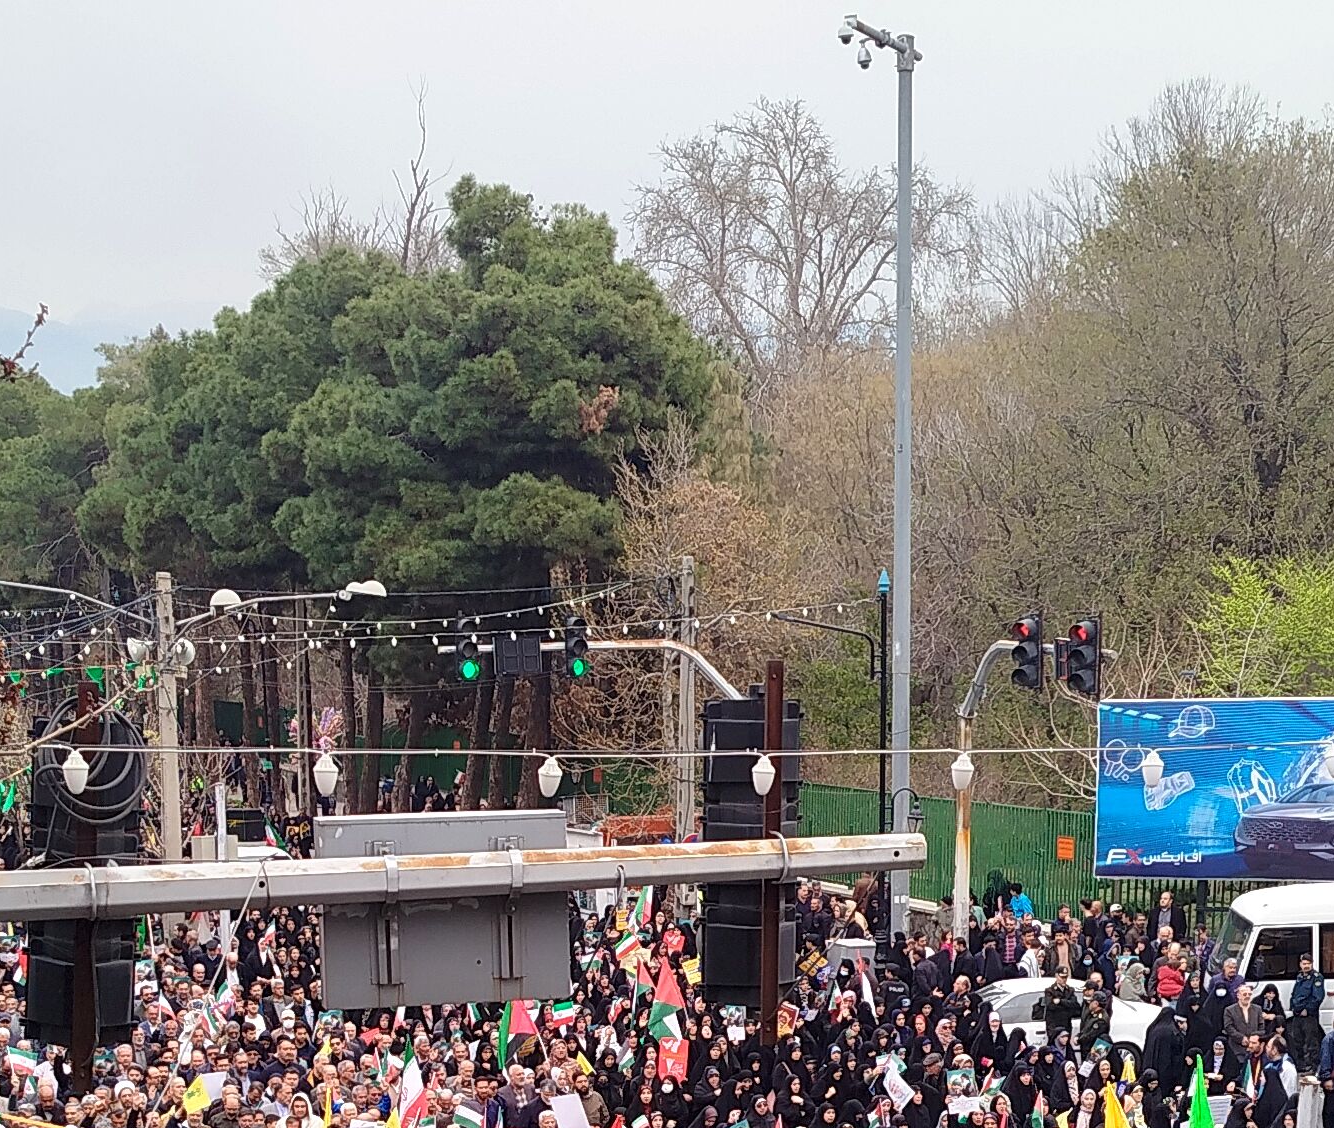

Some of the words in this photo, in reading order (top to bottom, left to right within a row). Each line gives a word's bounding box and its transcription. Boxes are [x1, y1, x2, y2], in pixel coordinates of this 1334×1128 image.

[1105, 848, 1144, 866] FX
[1142, 851, 1185, 866] ایکس
[1185, 849, 1202, 863] اف
